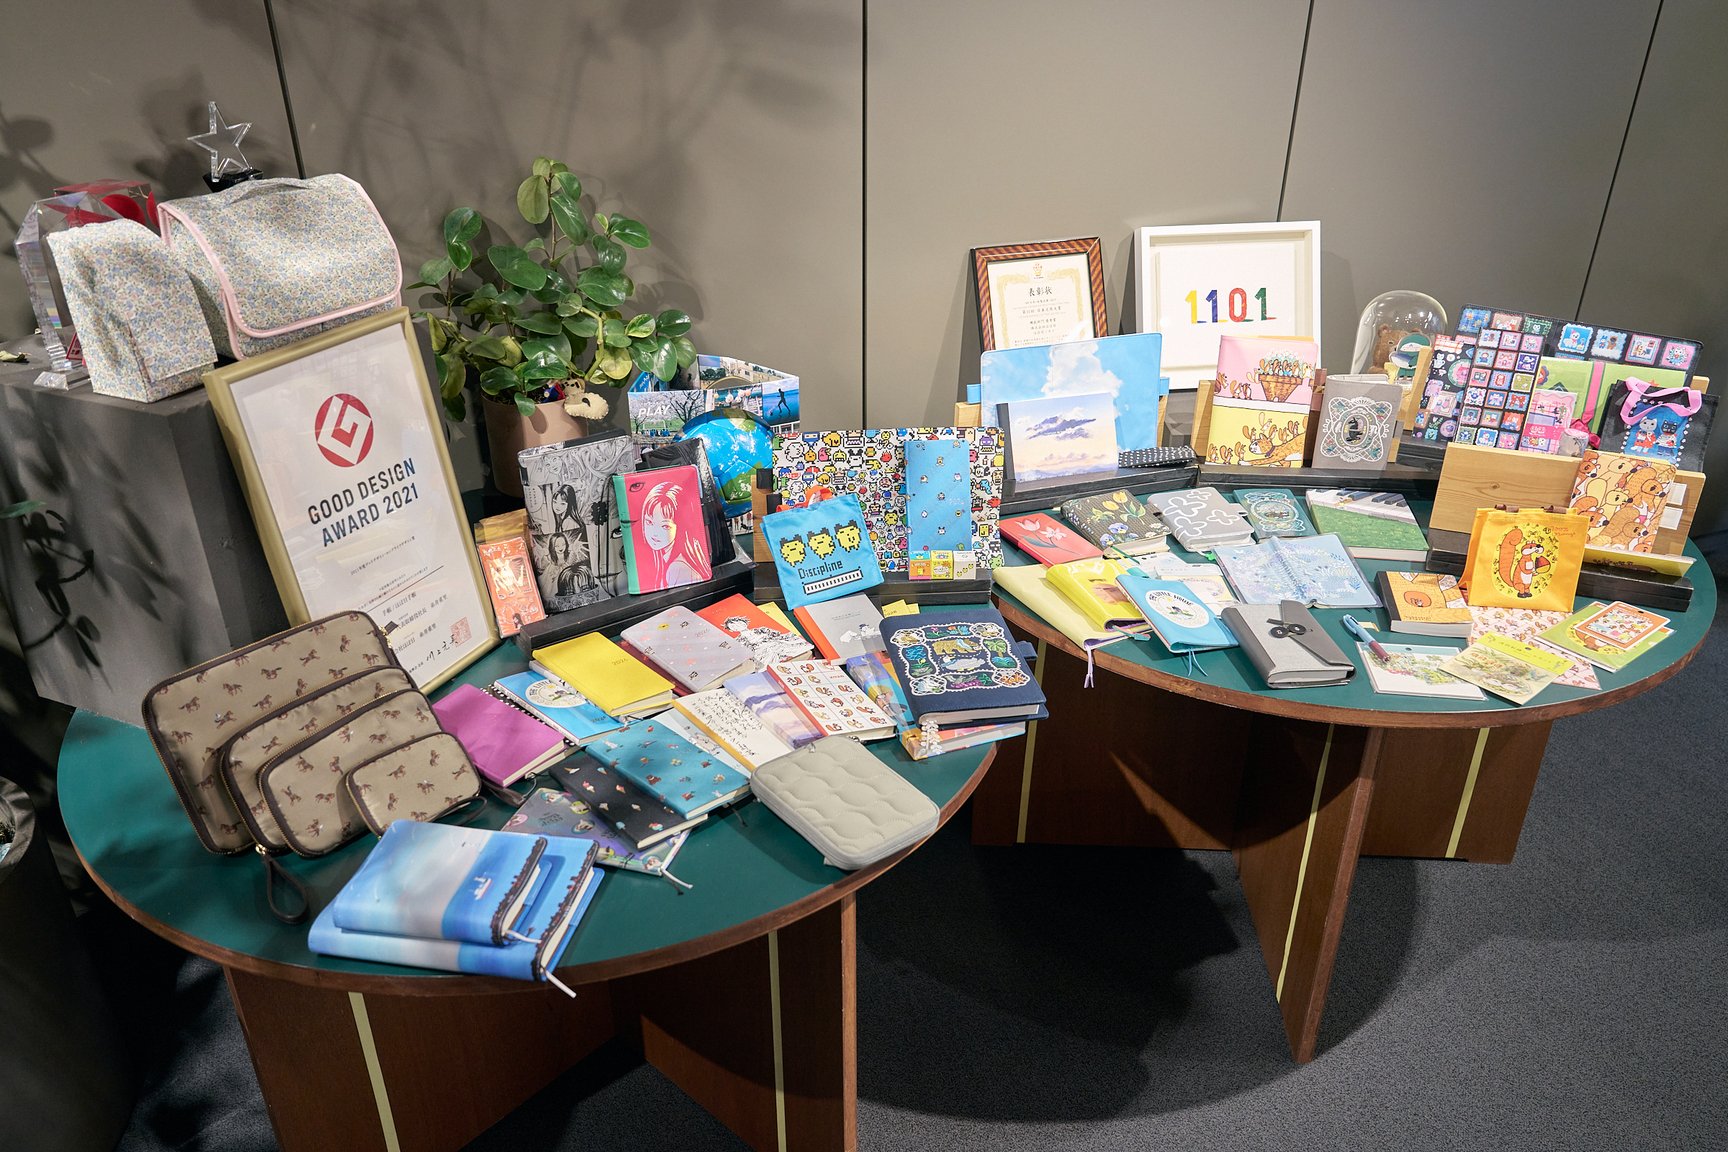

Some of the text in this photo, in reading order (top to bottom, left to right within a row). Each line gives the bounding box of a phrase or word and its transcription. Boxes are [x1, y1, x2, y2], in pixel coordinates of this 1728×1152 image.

[1185, 287, 1277, 324] 1101
[638, 405, 671, 418] PLAY
[308, 457, 416, 525] GOOD DESIGN
[322, 482, 419, 548] AWARD 2021
[798, 560, 843, 579] Discipline
